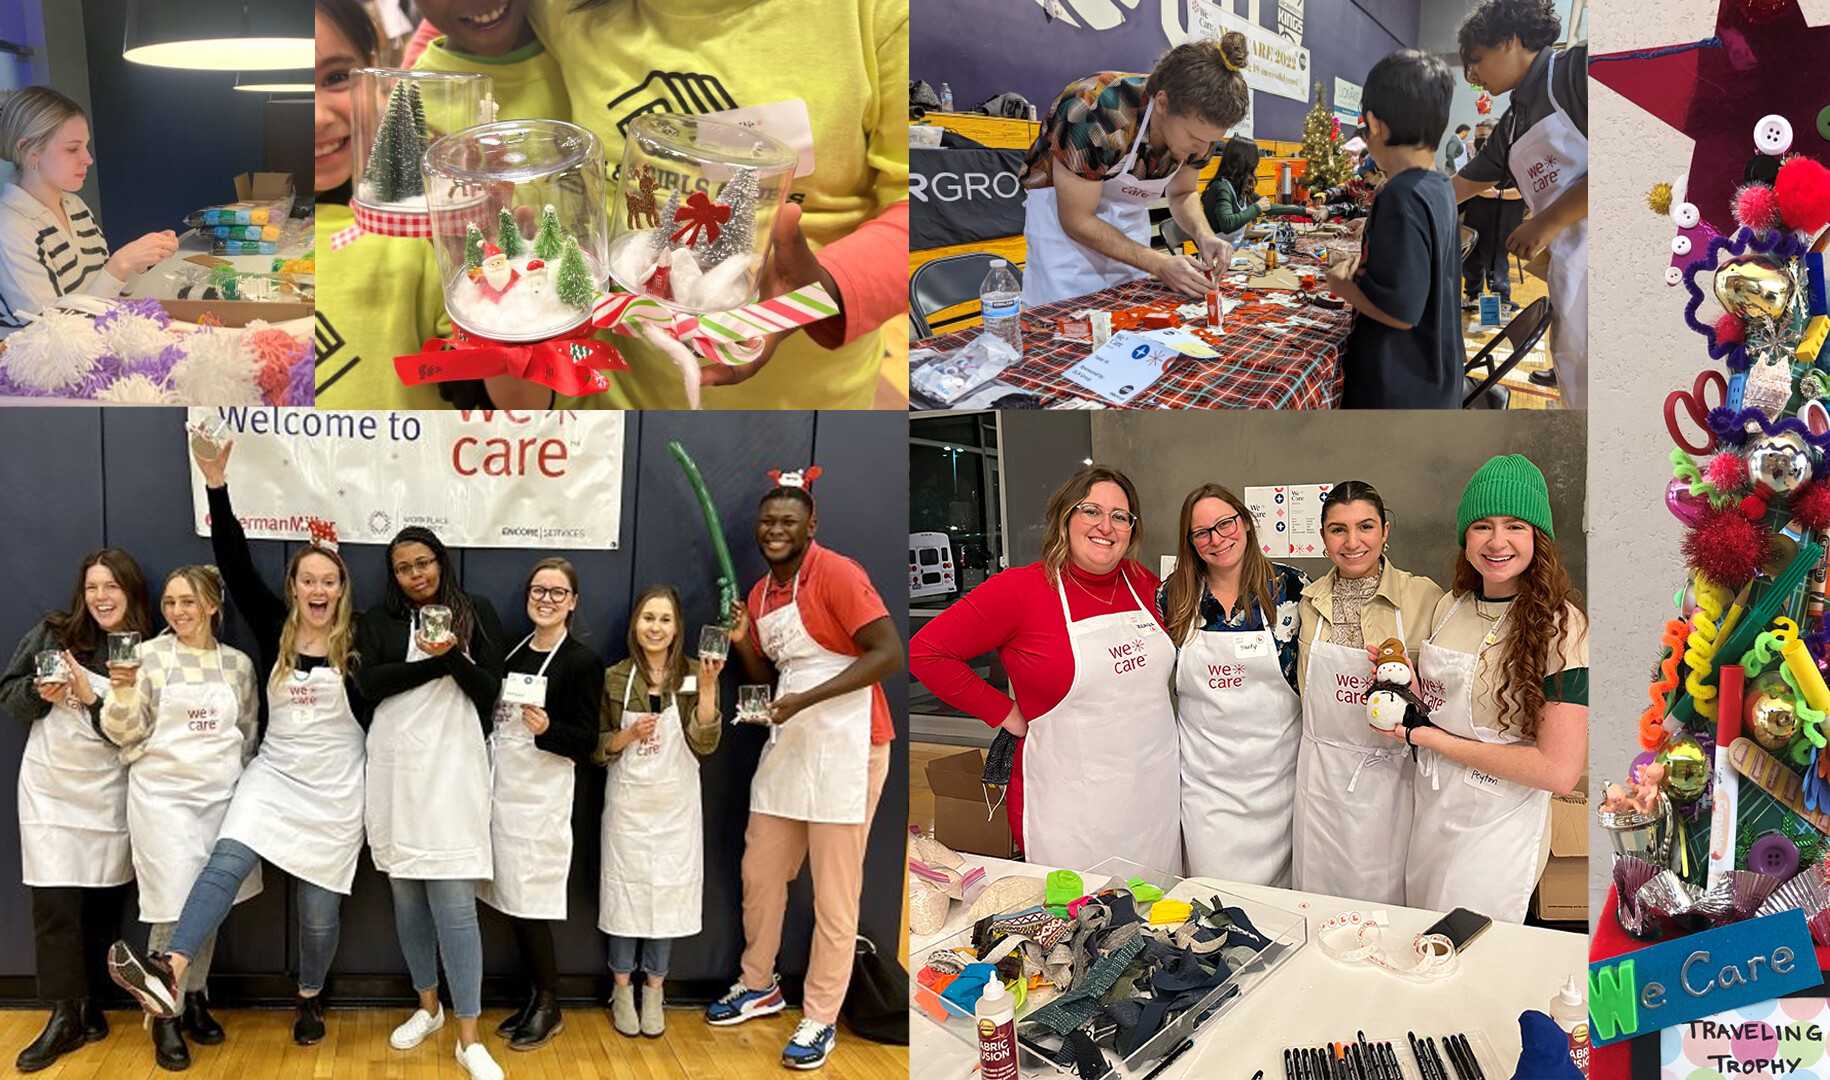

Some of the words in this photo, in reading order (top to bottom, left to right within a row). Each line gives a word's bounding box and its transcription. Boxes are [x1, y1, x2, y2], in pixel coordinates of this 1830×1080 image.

[1278, 7, 1303, 34] KINGS
[1250, 39, 1273, 61] ARE
[1275, 50, 1296, 70] 2022
[1527, 162, 1545, 179] we
[1533, 171, 1558, 192] care
[219, 407, 376, 439] Welcome
[389, 412, 420, 440] to
[453, 437, 567, 477] care
[1108, 642, 1133, 660] we
[1114, 655, 1146, 675] care
[1207, 664, 1231, 676] we
[1208, 676, 1243, 689] care
[1335, 673, 1359, 688] we
[1421, 677, 1437, 693] we
[288, 686, 308, 696] we
[1336, 689, 1368, 705] care
[187, 709, 207, 719] we
[188, 719, 216, 731] care
[1589, 959, 1667, 1040] We
[1681, 946, 1796, 997] Care
[1682, 1019, 1823, 1042] TRAVELING
[980, 1039, 1009, 1052] ABRIC
[980, 1048, 1010, 1062] USION
[1707, 1054, 1803, 1075] TROPHY
